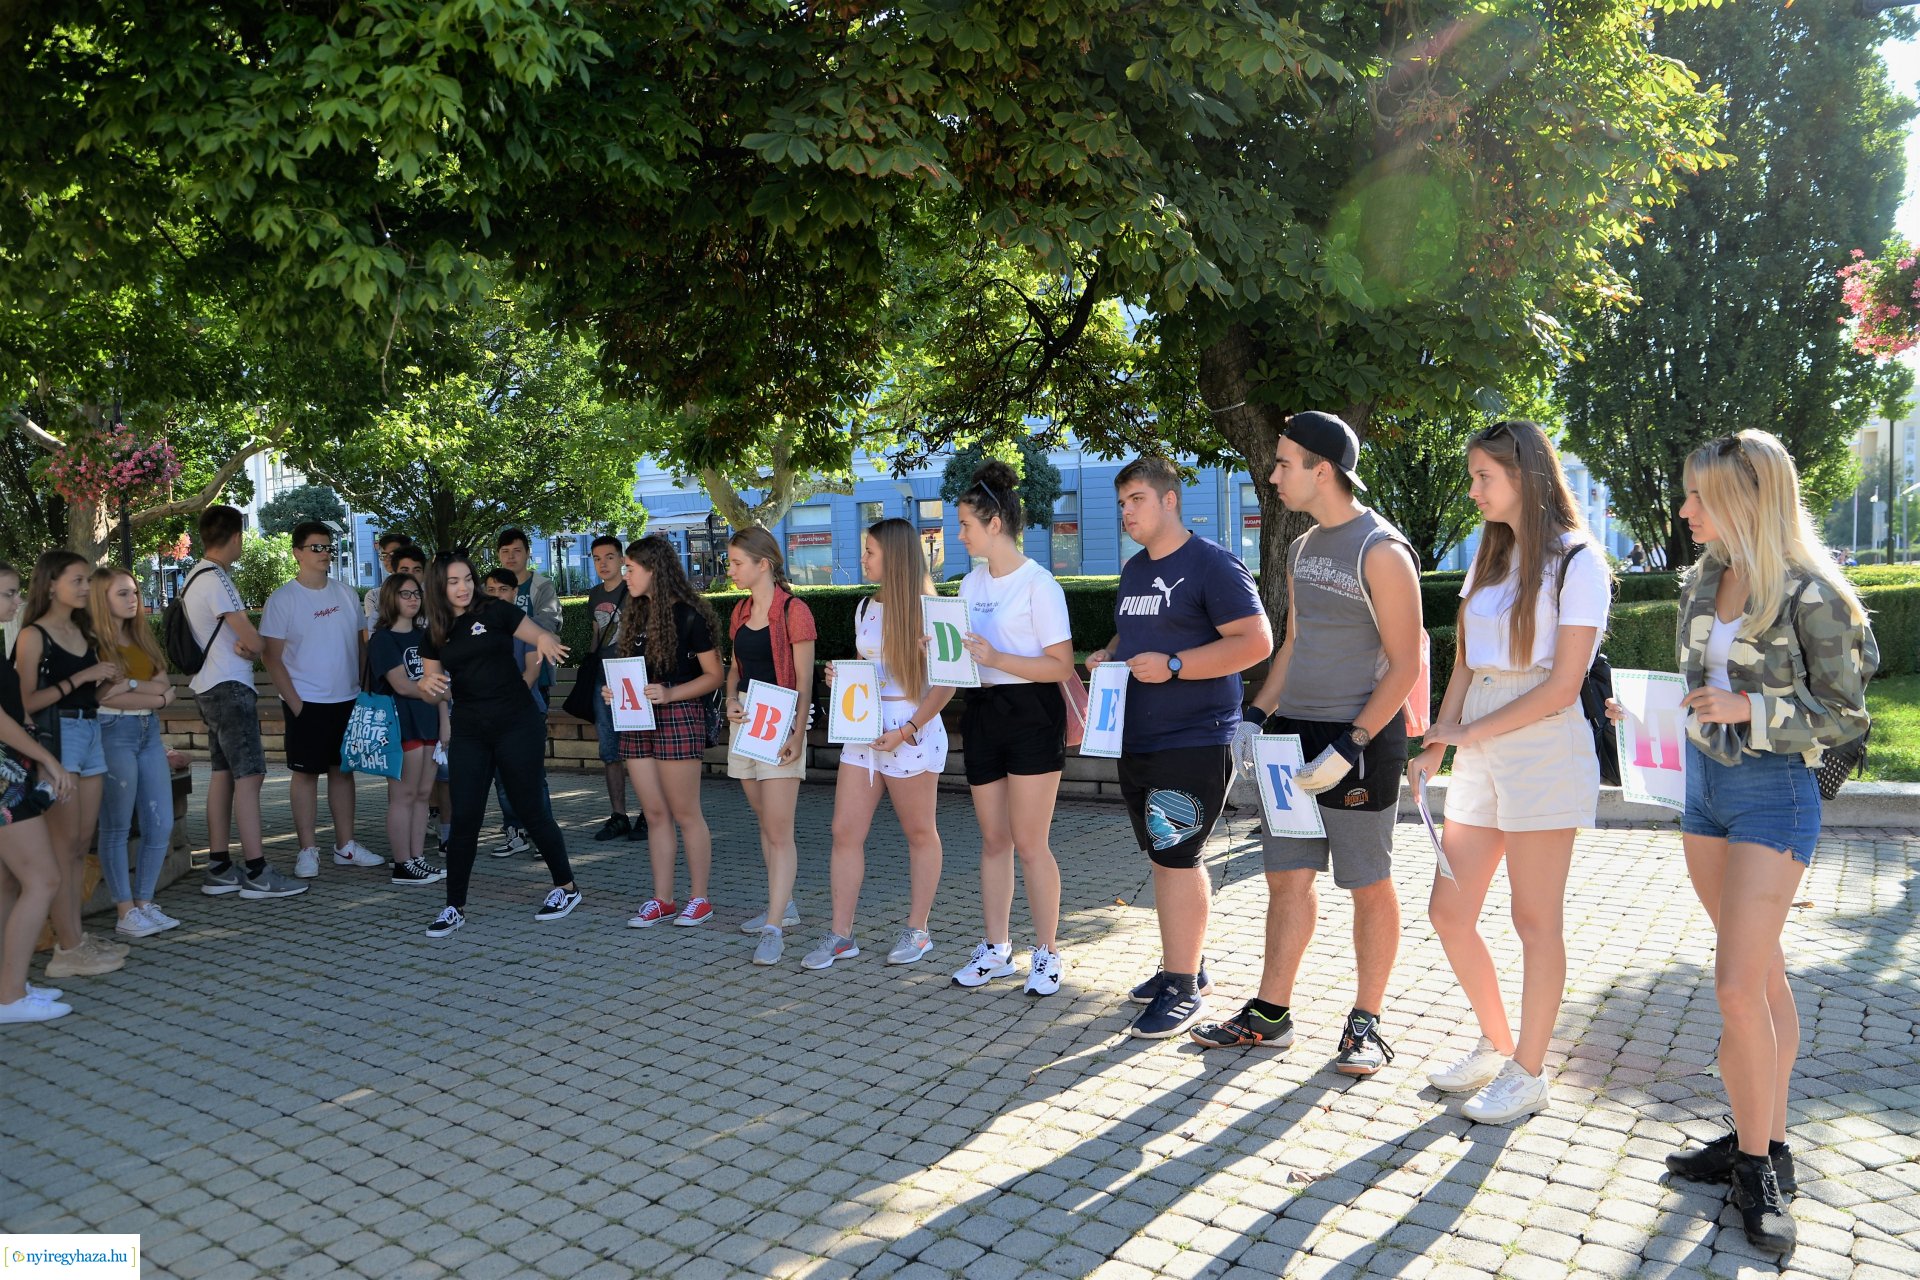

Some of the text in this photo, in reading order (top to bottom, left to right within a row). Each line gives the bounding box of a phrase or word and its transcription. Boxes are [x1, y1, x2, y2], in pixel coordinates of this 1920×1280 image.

[1118, 594, 1163, 616] PUMA
[934, 622, 962, 662] D
[620, 677, 642, 711] A
[842, 683, 868, 722] C
[1096, 689, 1120, 732] E
[748, 702, 782, 741] B
[1266, 763, 1297, 811] F
